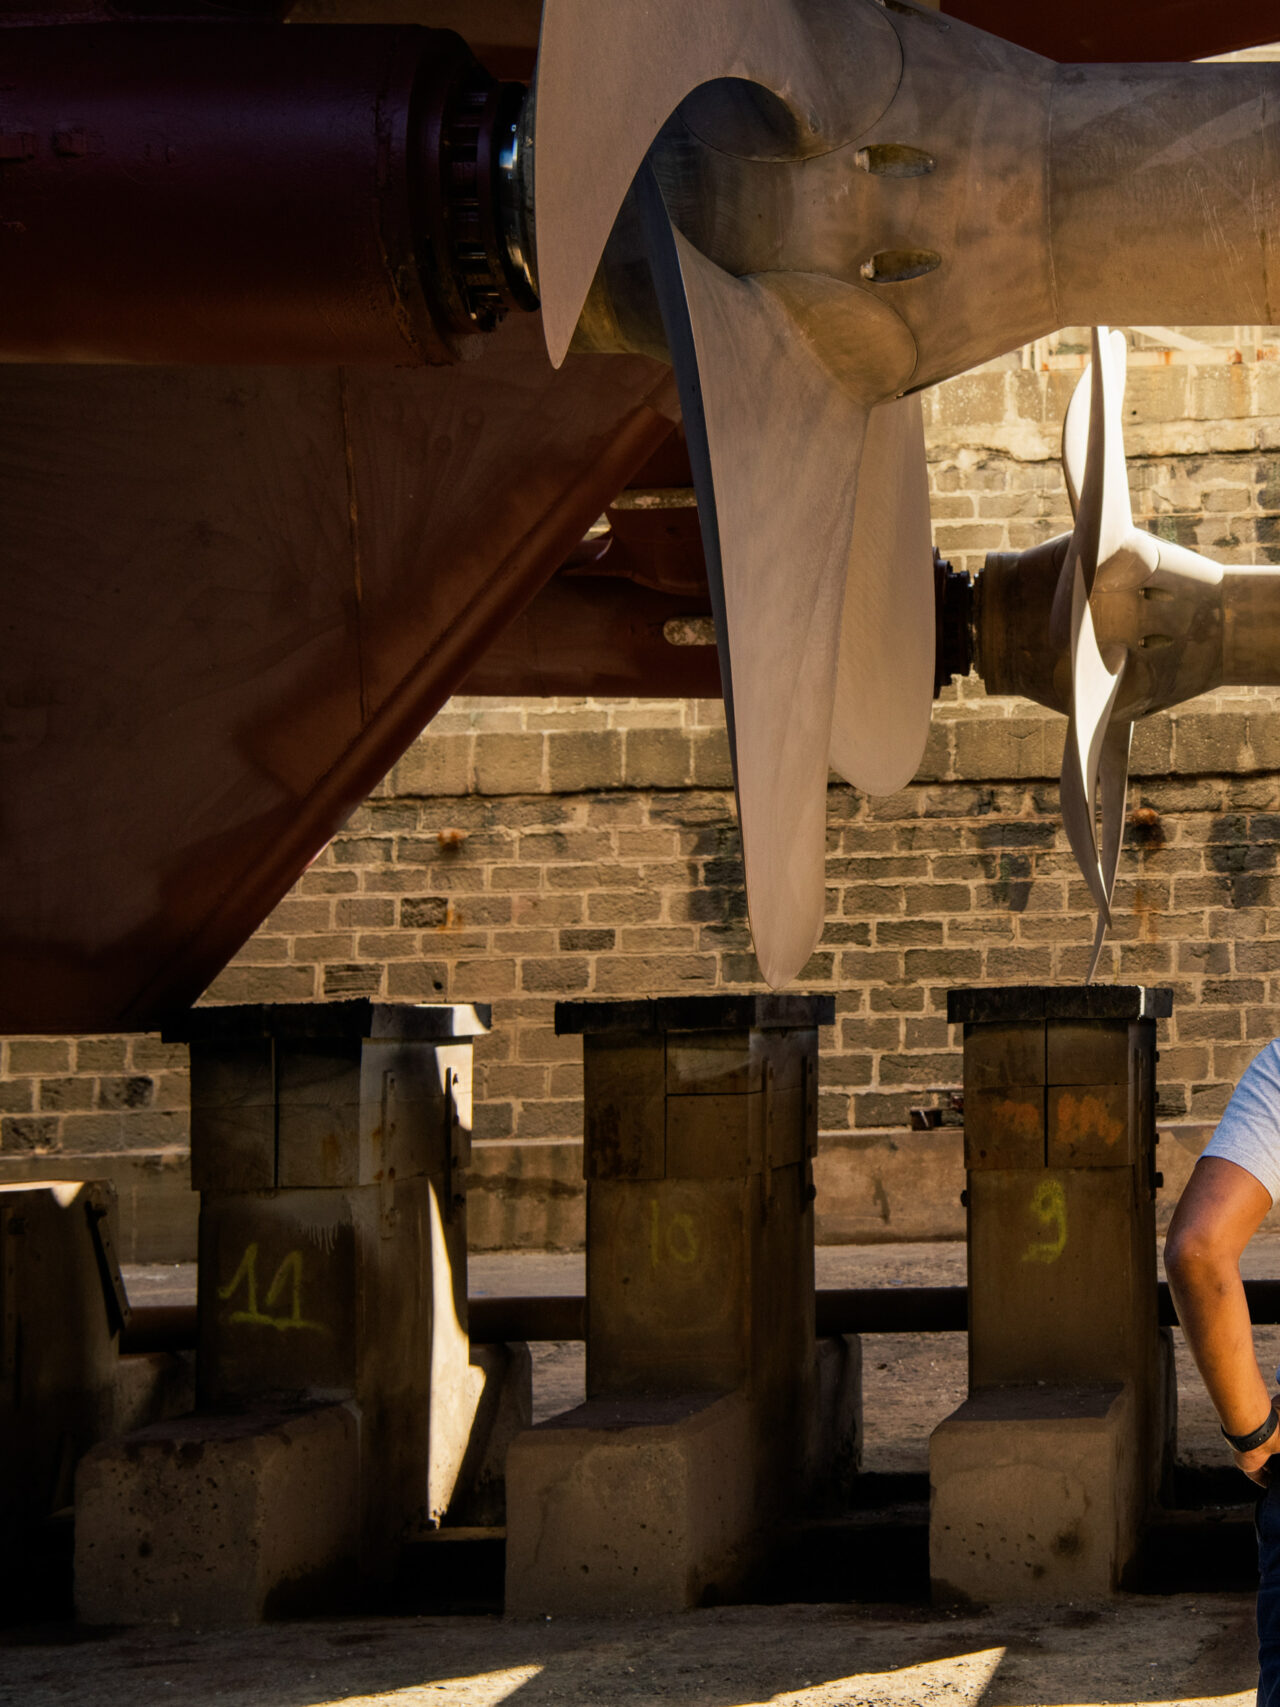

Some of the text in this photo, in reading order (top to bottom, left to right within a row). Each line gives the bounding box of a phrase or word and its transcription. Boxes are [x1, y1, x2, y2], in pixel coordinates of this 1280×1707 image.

[651, 1199, 700, 1269] 10
[1021, 1179, 1068, 1264] 9
[219, 1242, 325, 1329] 11
